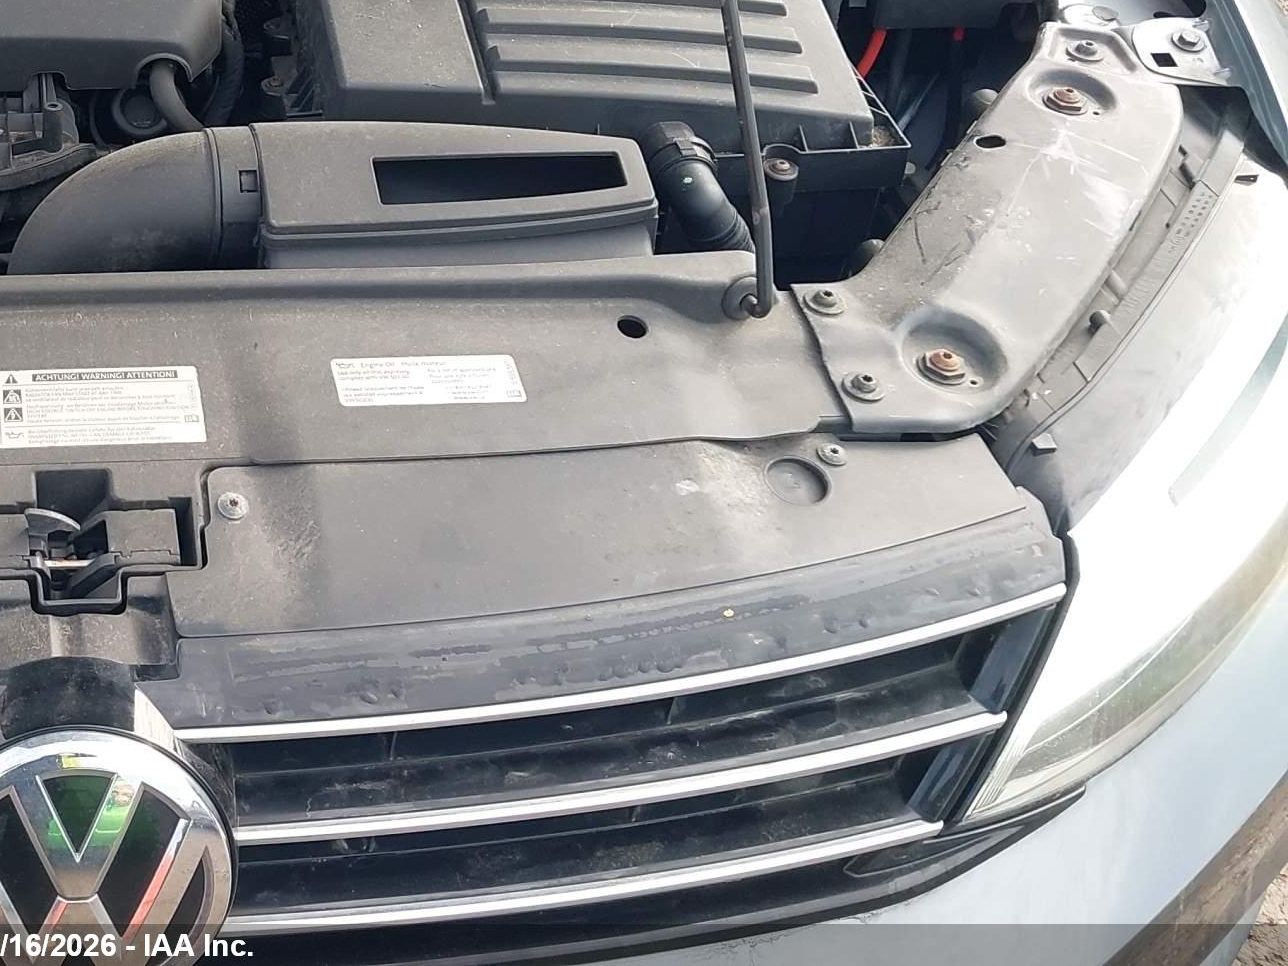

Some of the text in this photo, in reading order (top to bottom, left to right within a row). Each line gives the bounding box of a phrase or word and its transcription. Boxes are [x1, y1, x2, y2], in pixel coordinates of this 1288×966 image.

[35, 370, 175, 381] ACHTUNG! WARNING! ATTENTION!
